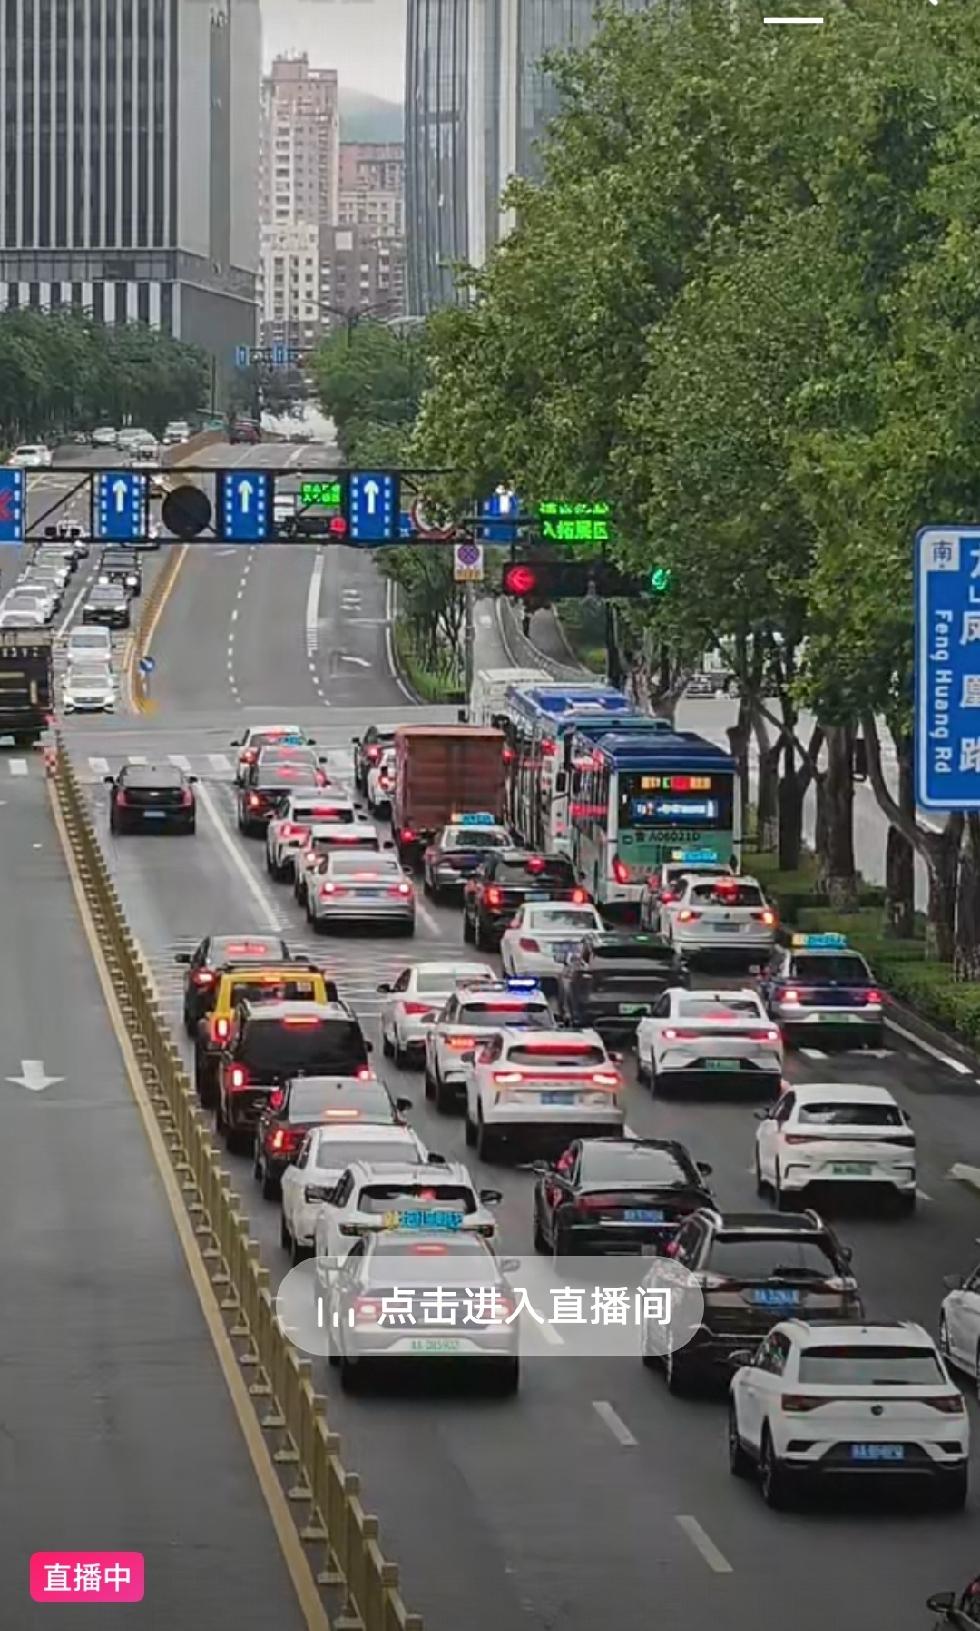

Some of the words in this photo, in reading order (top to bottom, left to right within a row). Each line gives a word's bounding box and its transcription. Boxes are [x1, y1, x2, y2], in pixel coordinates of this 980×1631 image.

[932, 540, 953, 561] 南
[930, 609, 953, 661] Feng
[930, 669, 953, 739] Huang
[935, 746, 953, 774] Rd
